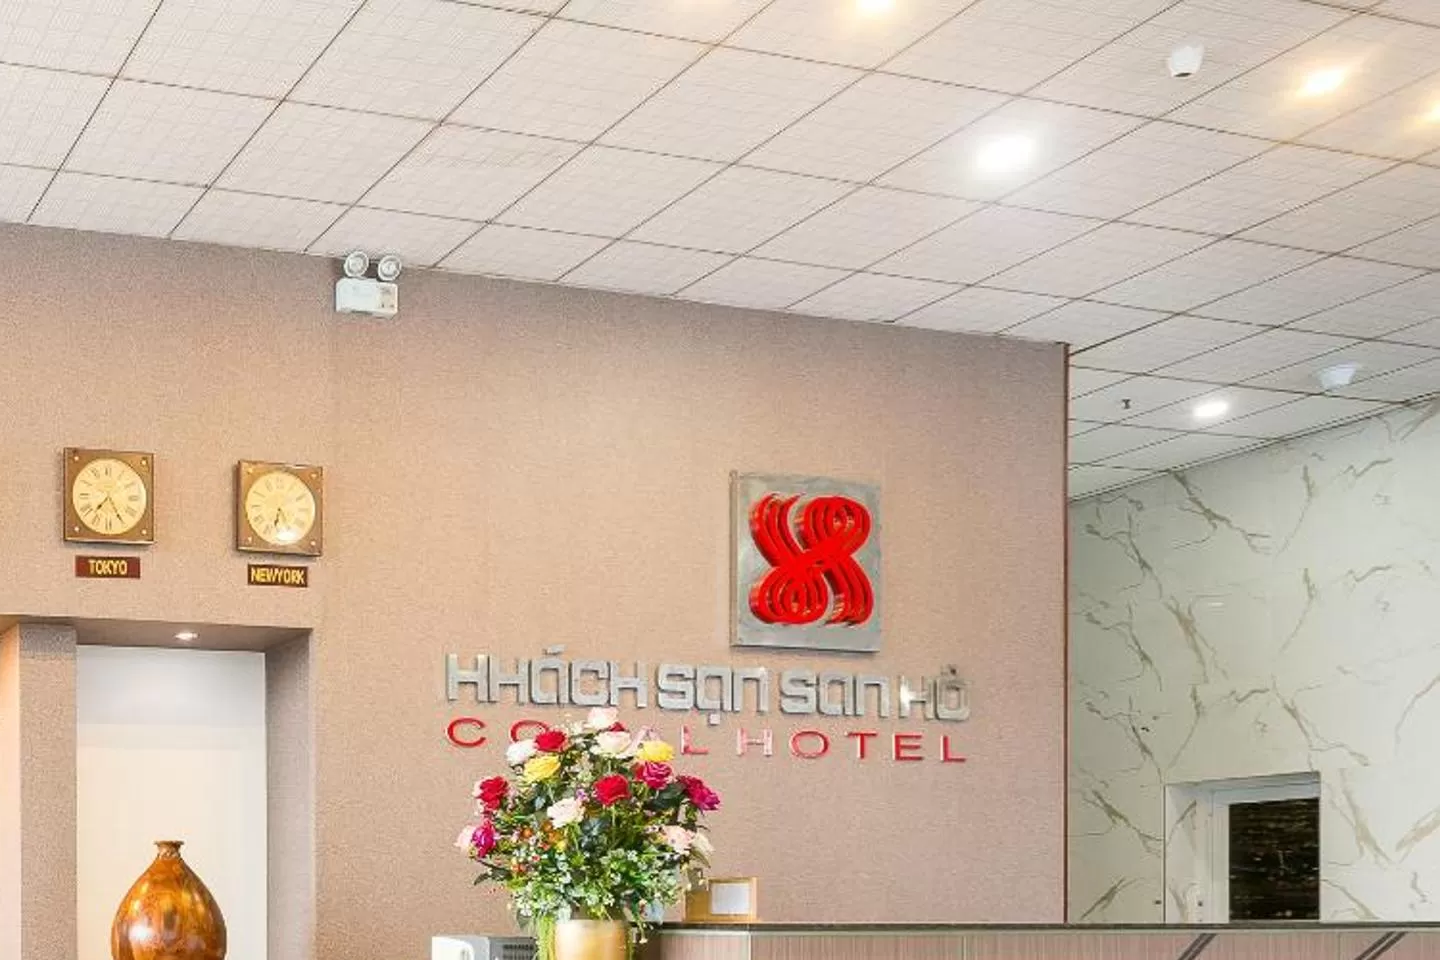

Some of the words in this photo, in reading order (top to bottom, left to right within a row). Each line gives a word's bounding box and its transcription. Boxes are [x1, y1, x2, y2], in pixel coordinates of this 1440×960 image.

[88, 559, 128, 575] TOKYO
[251, 567, 305, 584] NEWYORK
[737, 727, 967, 764] HOTEL
